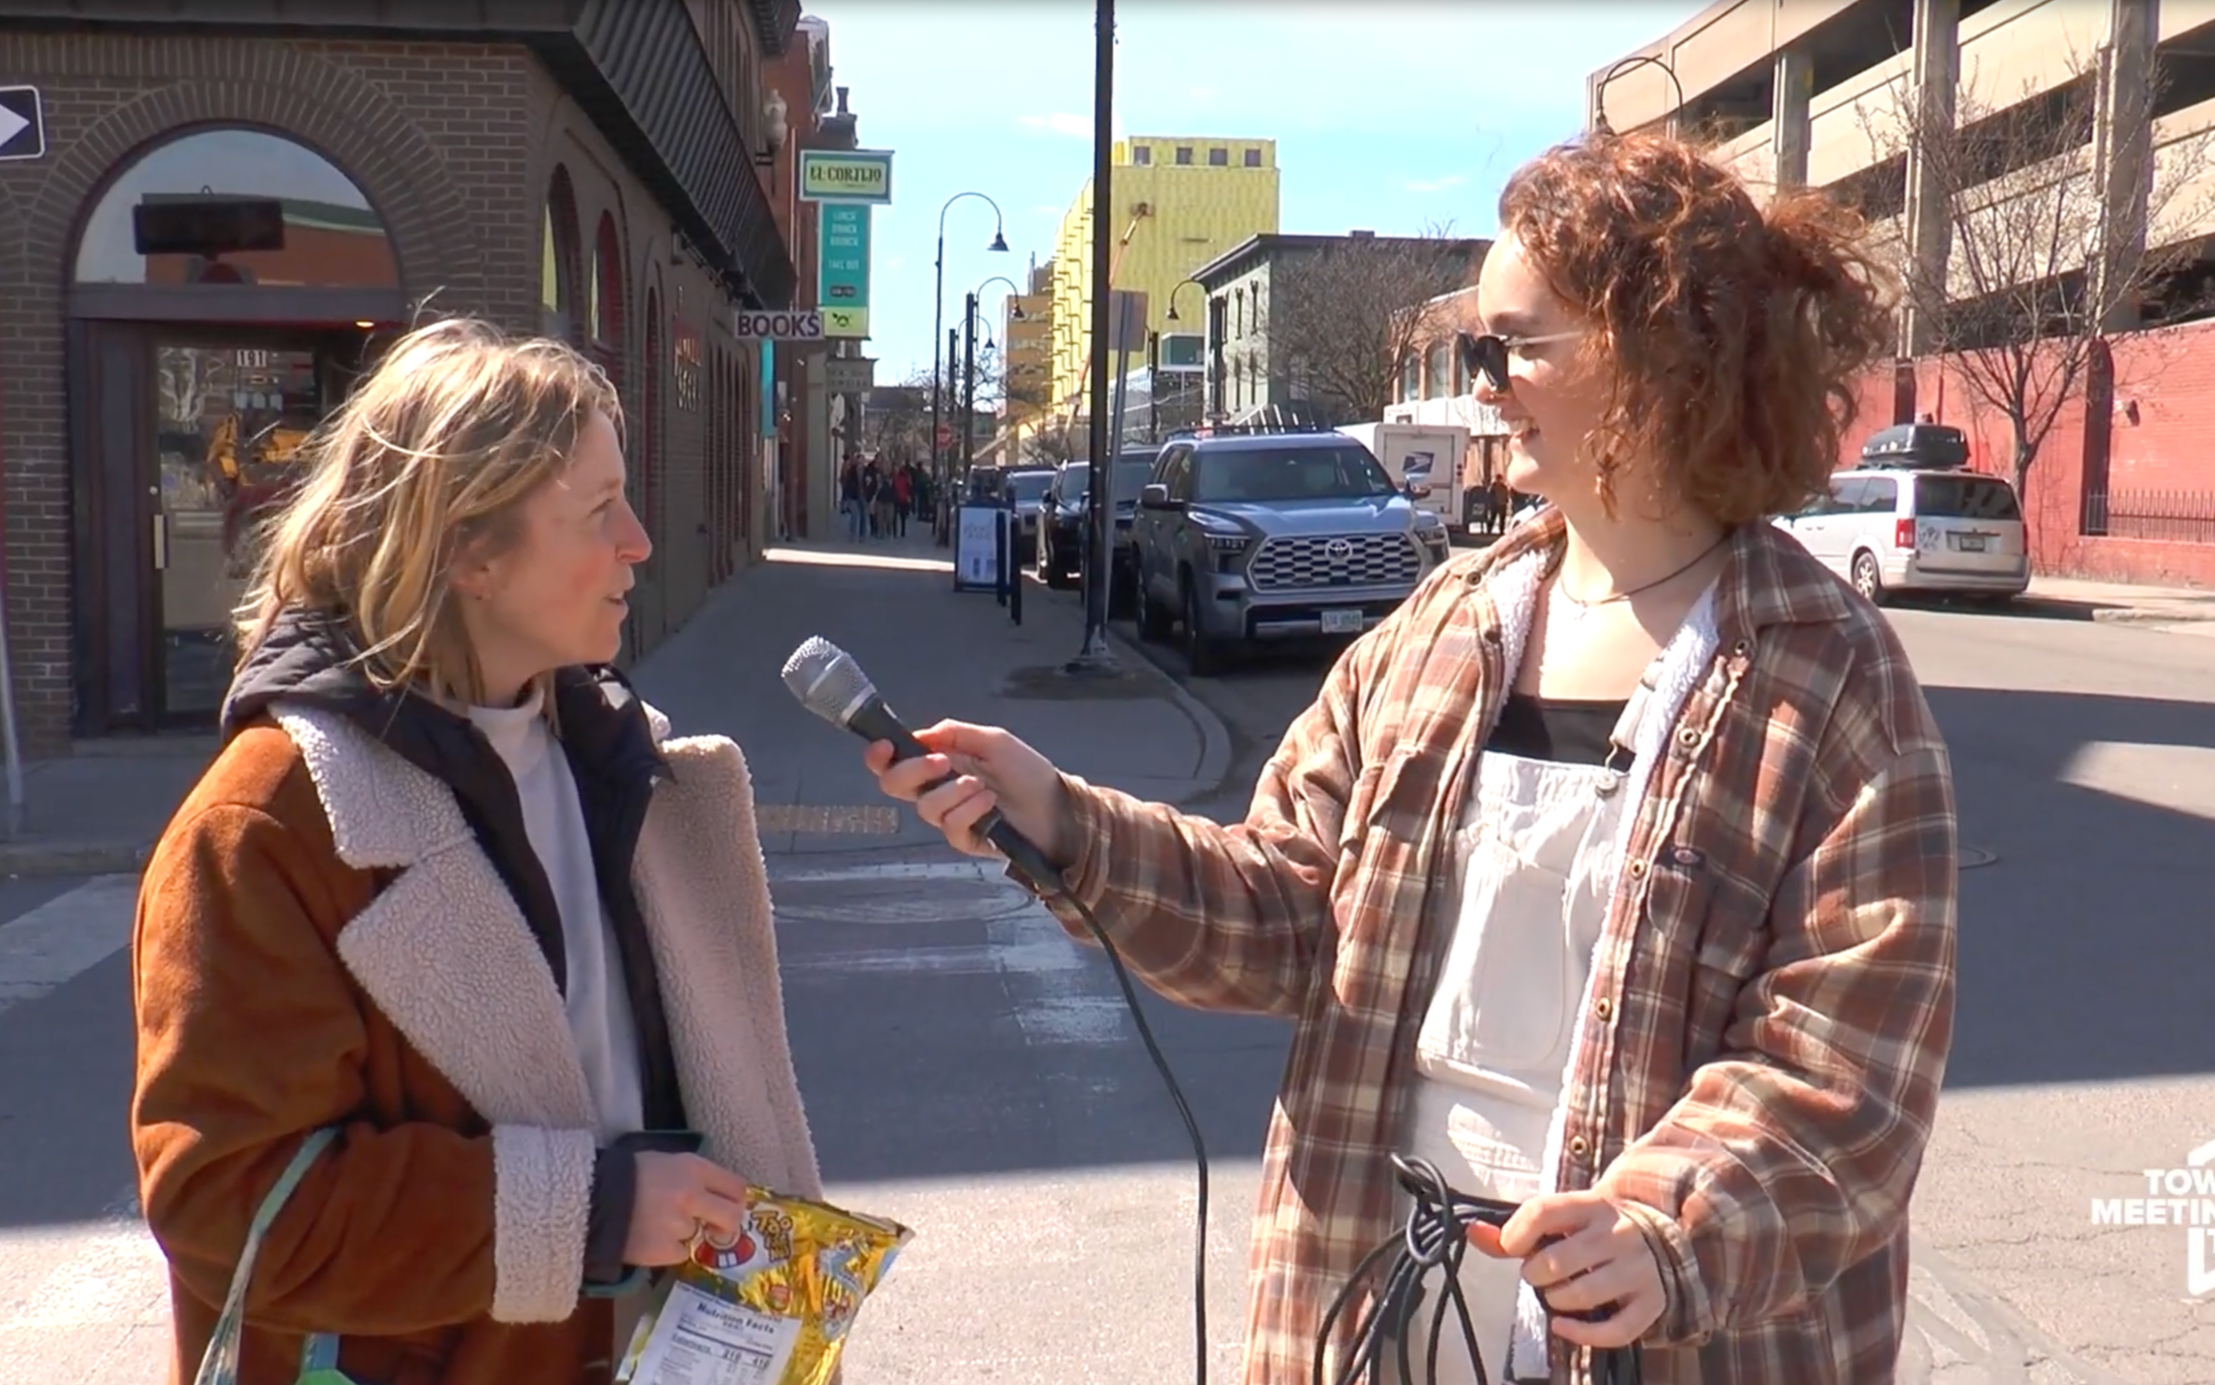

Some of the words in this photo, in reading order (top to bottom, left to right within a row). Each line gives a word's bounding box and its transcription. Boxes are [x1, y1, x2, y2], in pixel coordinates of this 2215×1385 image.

[810, 166, 823, 181] EL
[737, 315, 820, 337] BOOKS
[697, 1302, 744, 1326] Nutrition
[745, 1317, 776, 1335] Facts
